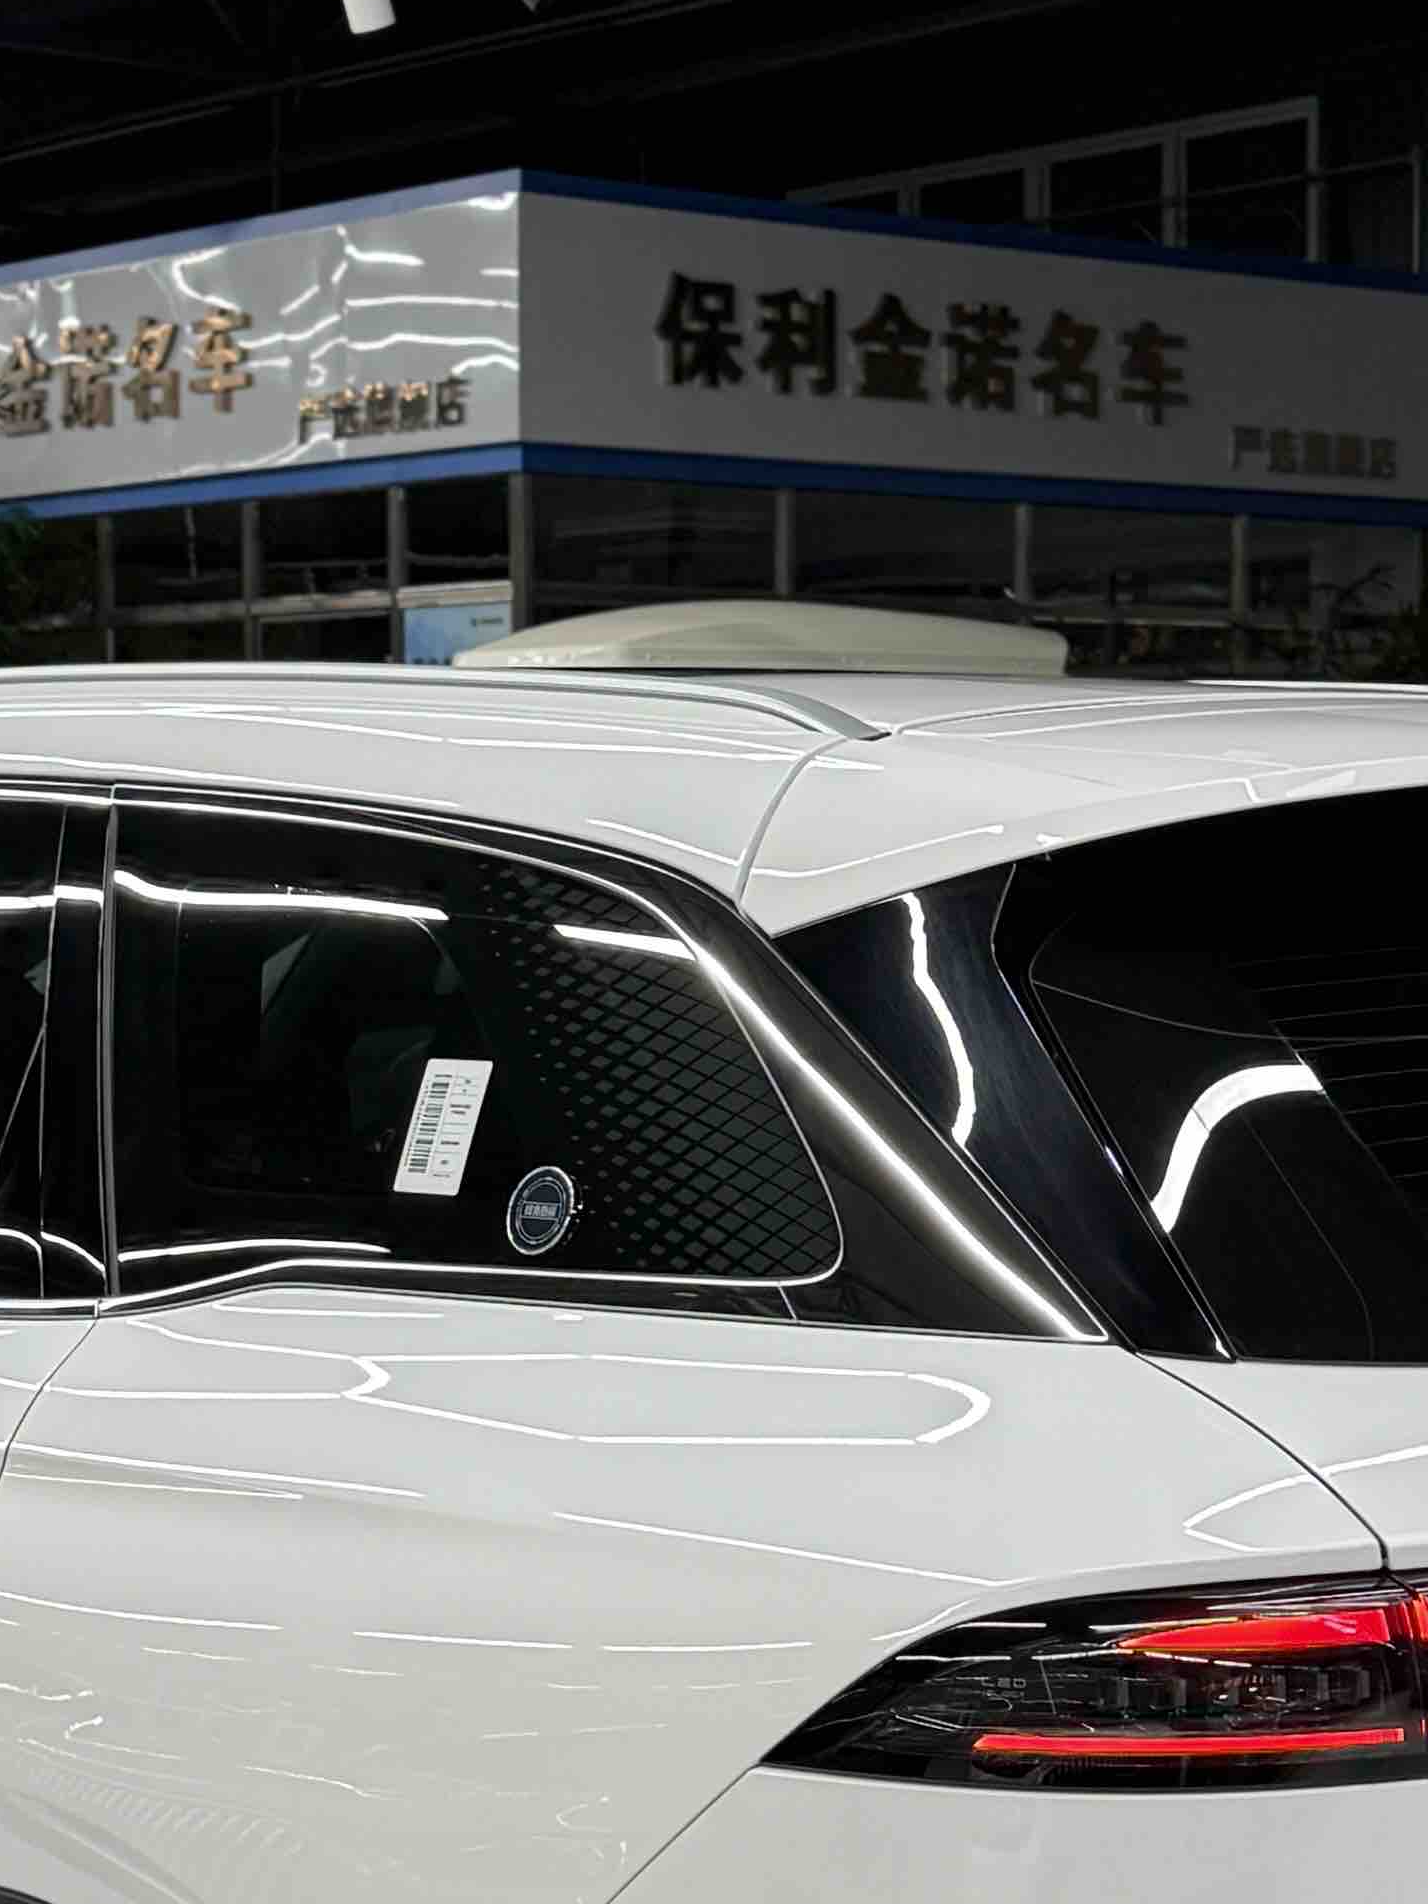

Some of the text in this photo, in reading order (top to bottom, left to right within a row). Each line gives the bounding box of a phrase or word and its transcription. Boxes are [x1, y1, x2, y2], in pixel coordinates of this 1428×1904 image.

[656, 271, 1190, 425] 保利金诺名车
